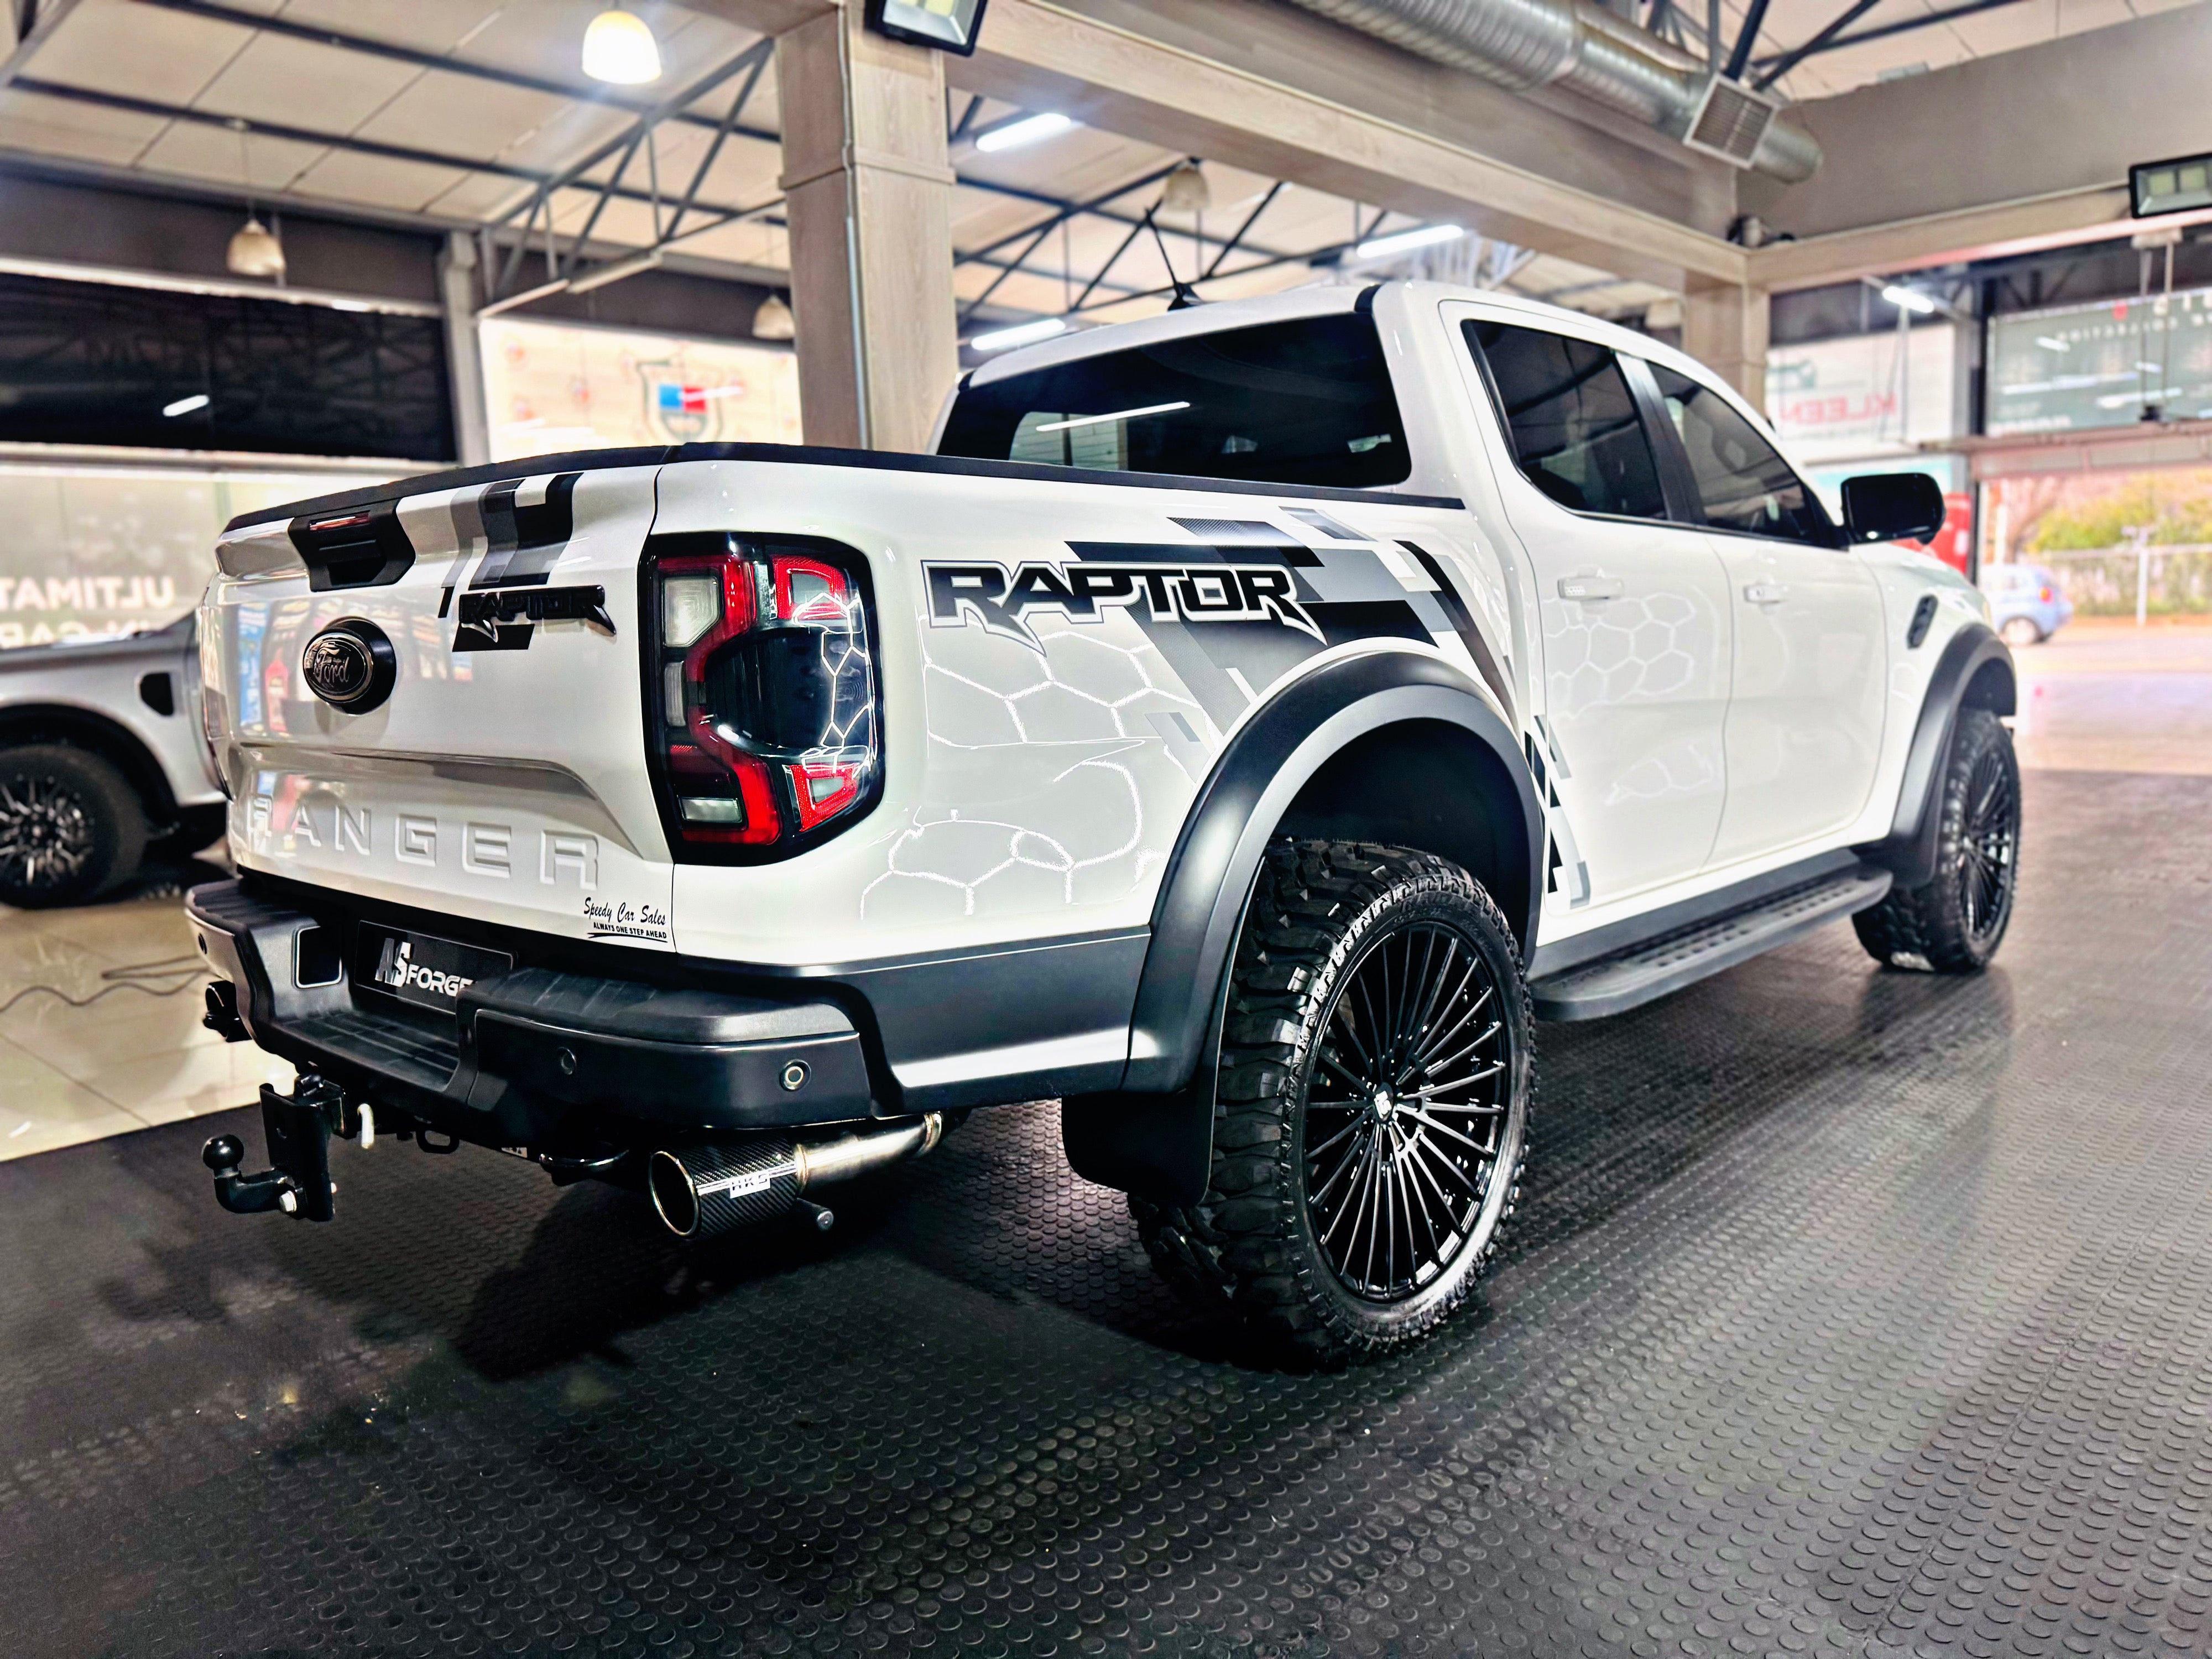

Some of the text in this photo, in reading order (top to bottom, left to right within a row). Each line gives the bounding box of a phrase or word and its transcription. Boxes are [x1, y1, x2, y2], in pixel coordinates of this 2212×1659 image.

[920, 560, 1328, 656] RAPTOR
[314, 642, 351, 684] Ford
[248, 795, 599, 891] RANGER
[584, 897, 666, 925] Speedy Car Sales
[593, 922, 615, 932] ALWAYS
[646, 930, 667, 938] AHEAD
[731, 1173, 768, 1191] HKS
